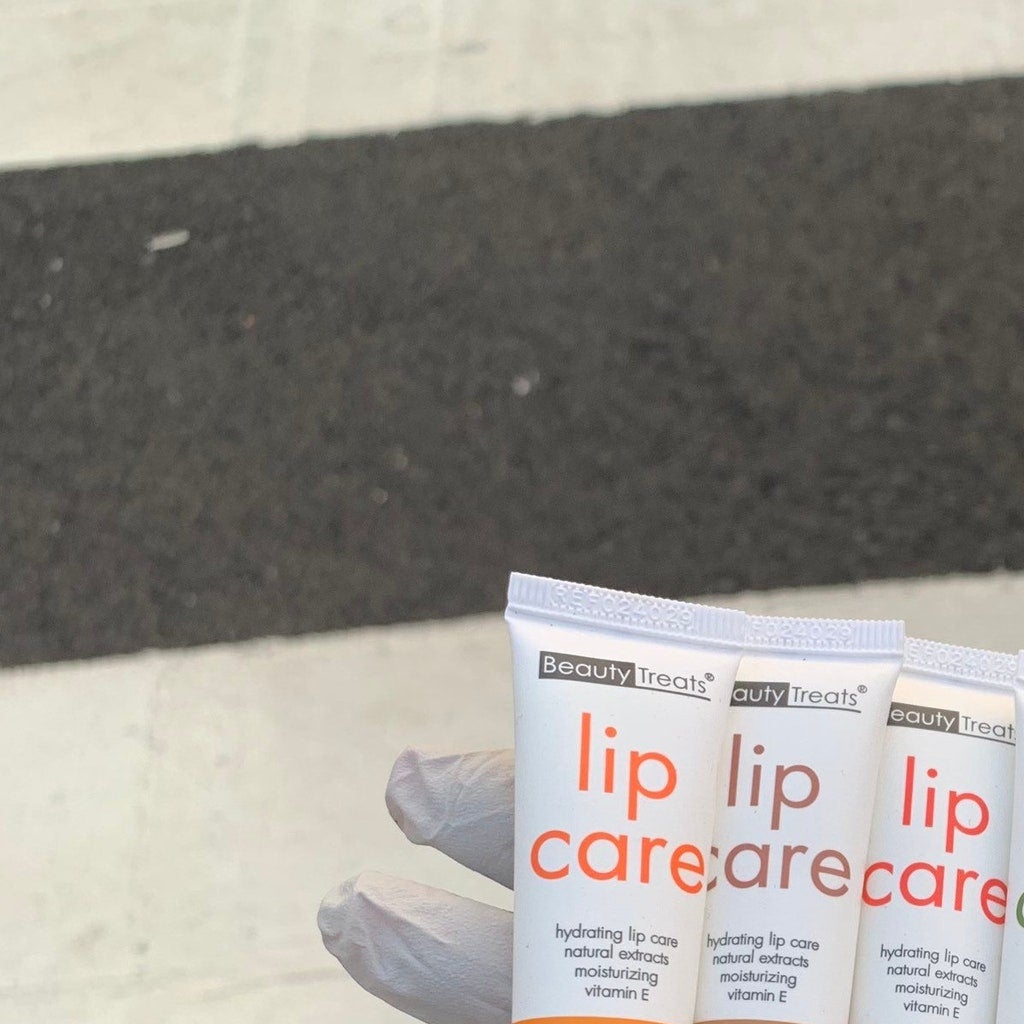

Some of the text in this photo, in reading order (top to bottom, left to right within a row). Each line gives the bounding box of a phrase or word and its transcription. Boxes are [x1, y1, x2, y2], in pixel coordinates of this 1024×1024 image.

[751, 620, 852, 640] F024029
[543, 656, 632, 685] Beauty
[732, 685, 786, 707] auty
[890, 708, 1016, 741] eauty Treat
[578, 711, 678, 821] lip
[727, 733, 820, 830] lip
[902, 755, 990, 853] lip
[530, 829, 705, 894] care
[861, 861, 1008, 926] care
[555, 924, 679, 948] hydrating lip care
[707, 932, 820, 951] hydrating lip care
[564, 945, 669, 966] natural extracts
[713, 951, 809, 969] natural extracts
[880, 944, 986, 973] hydrating lip care
[575, 965, 659, 986] moisturizing
[720, 970, 797, 989] moisturizing
[887, 964, 978, 989] natural extracts
[585, 985, 650, 1002] vitamin E
[727, 989, 787, 1003] vitamin E
[895, 982, 969, 1006] moisturizing
[903, 1001, 960, 1019] vitamin E
